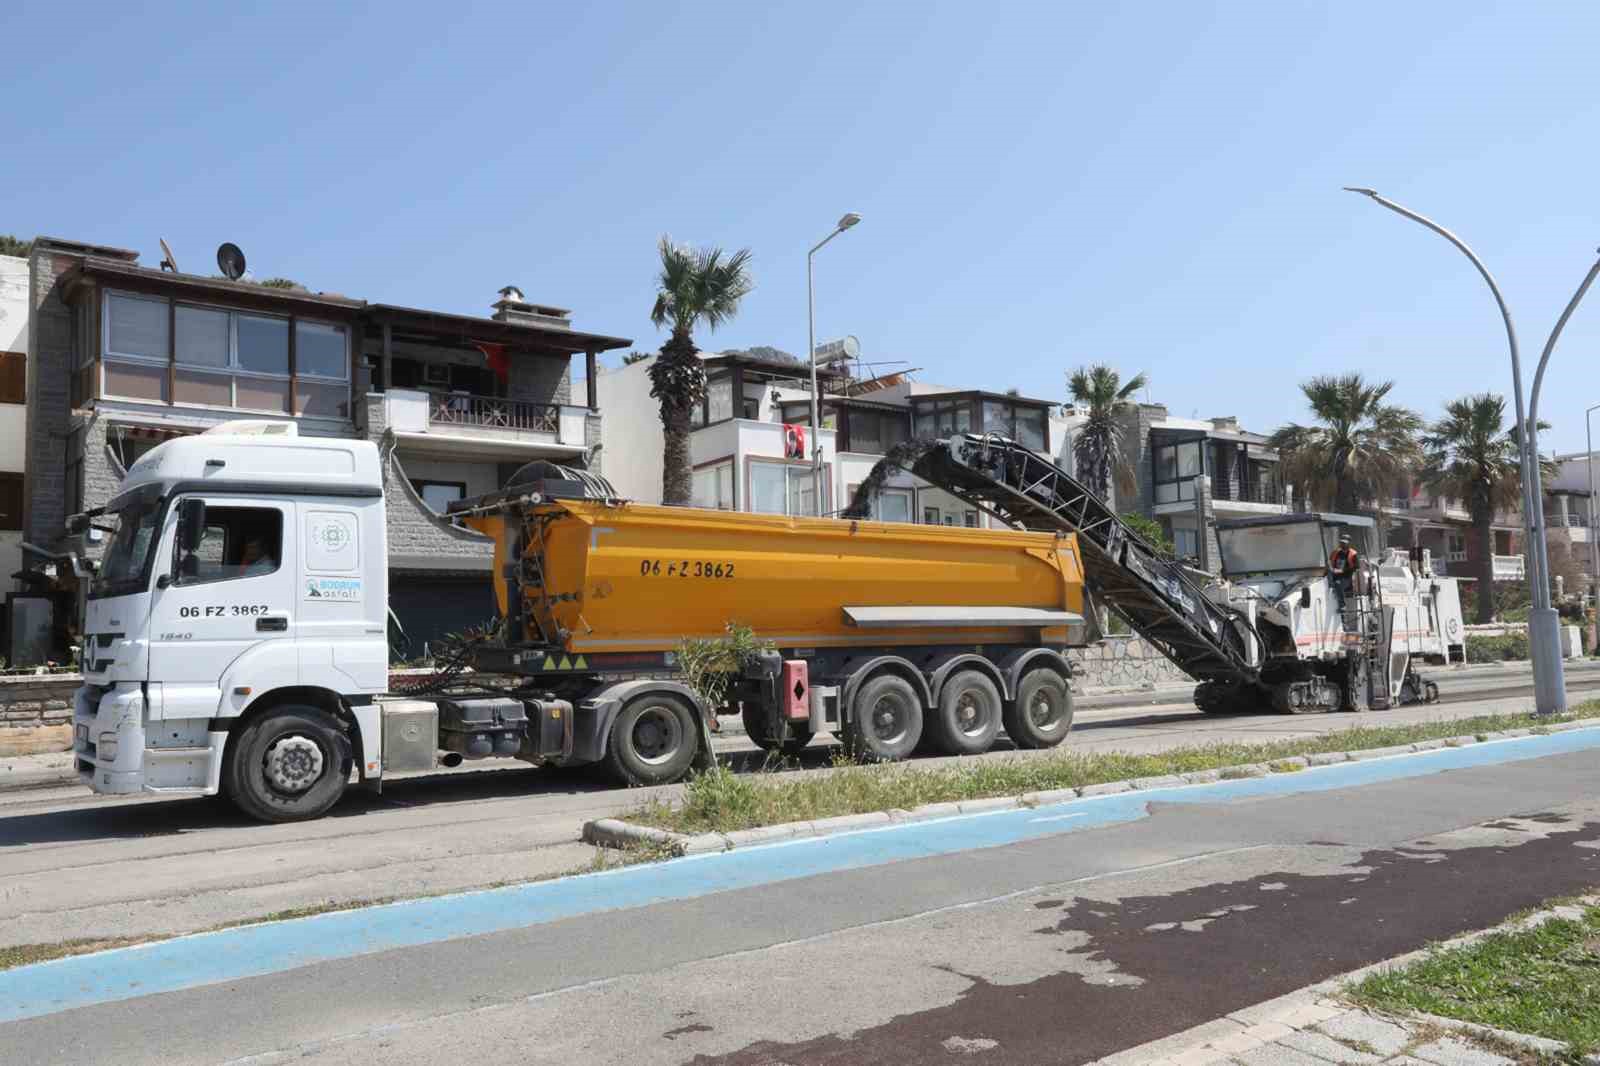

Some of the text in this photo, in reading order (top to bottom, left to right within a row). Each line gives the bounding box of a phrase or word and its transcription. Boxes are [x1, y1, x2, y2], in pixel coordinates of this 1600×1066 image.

[641, 559, 734, 578] 06 FZ 3862
[180, 605, 269, 618] 06 FZ 3862
